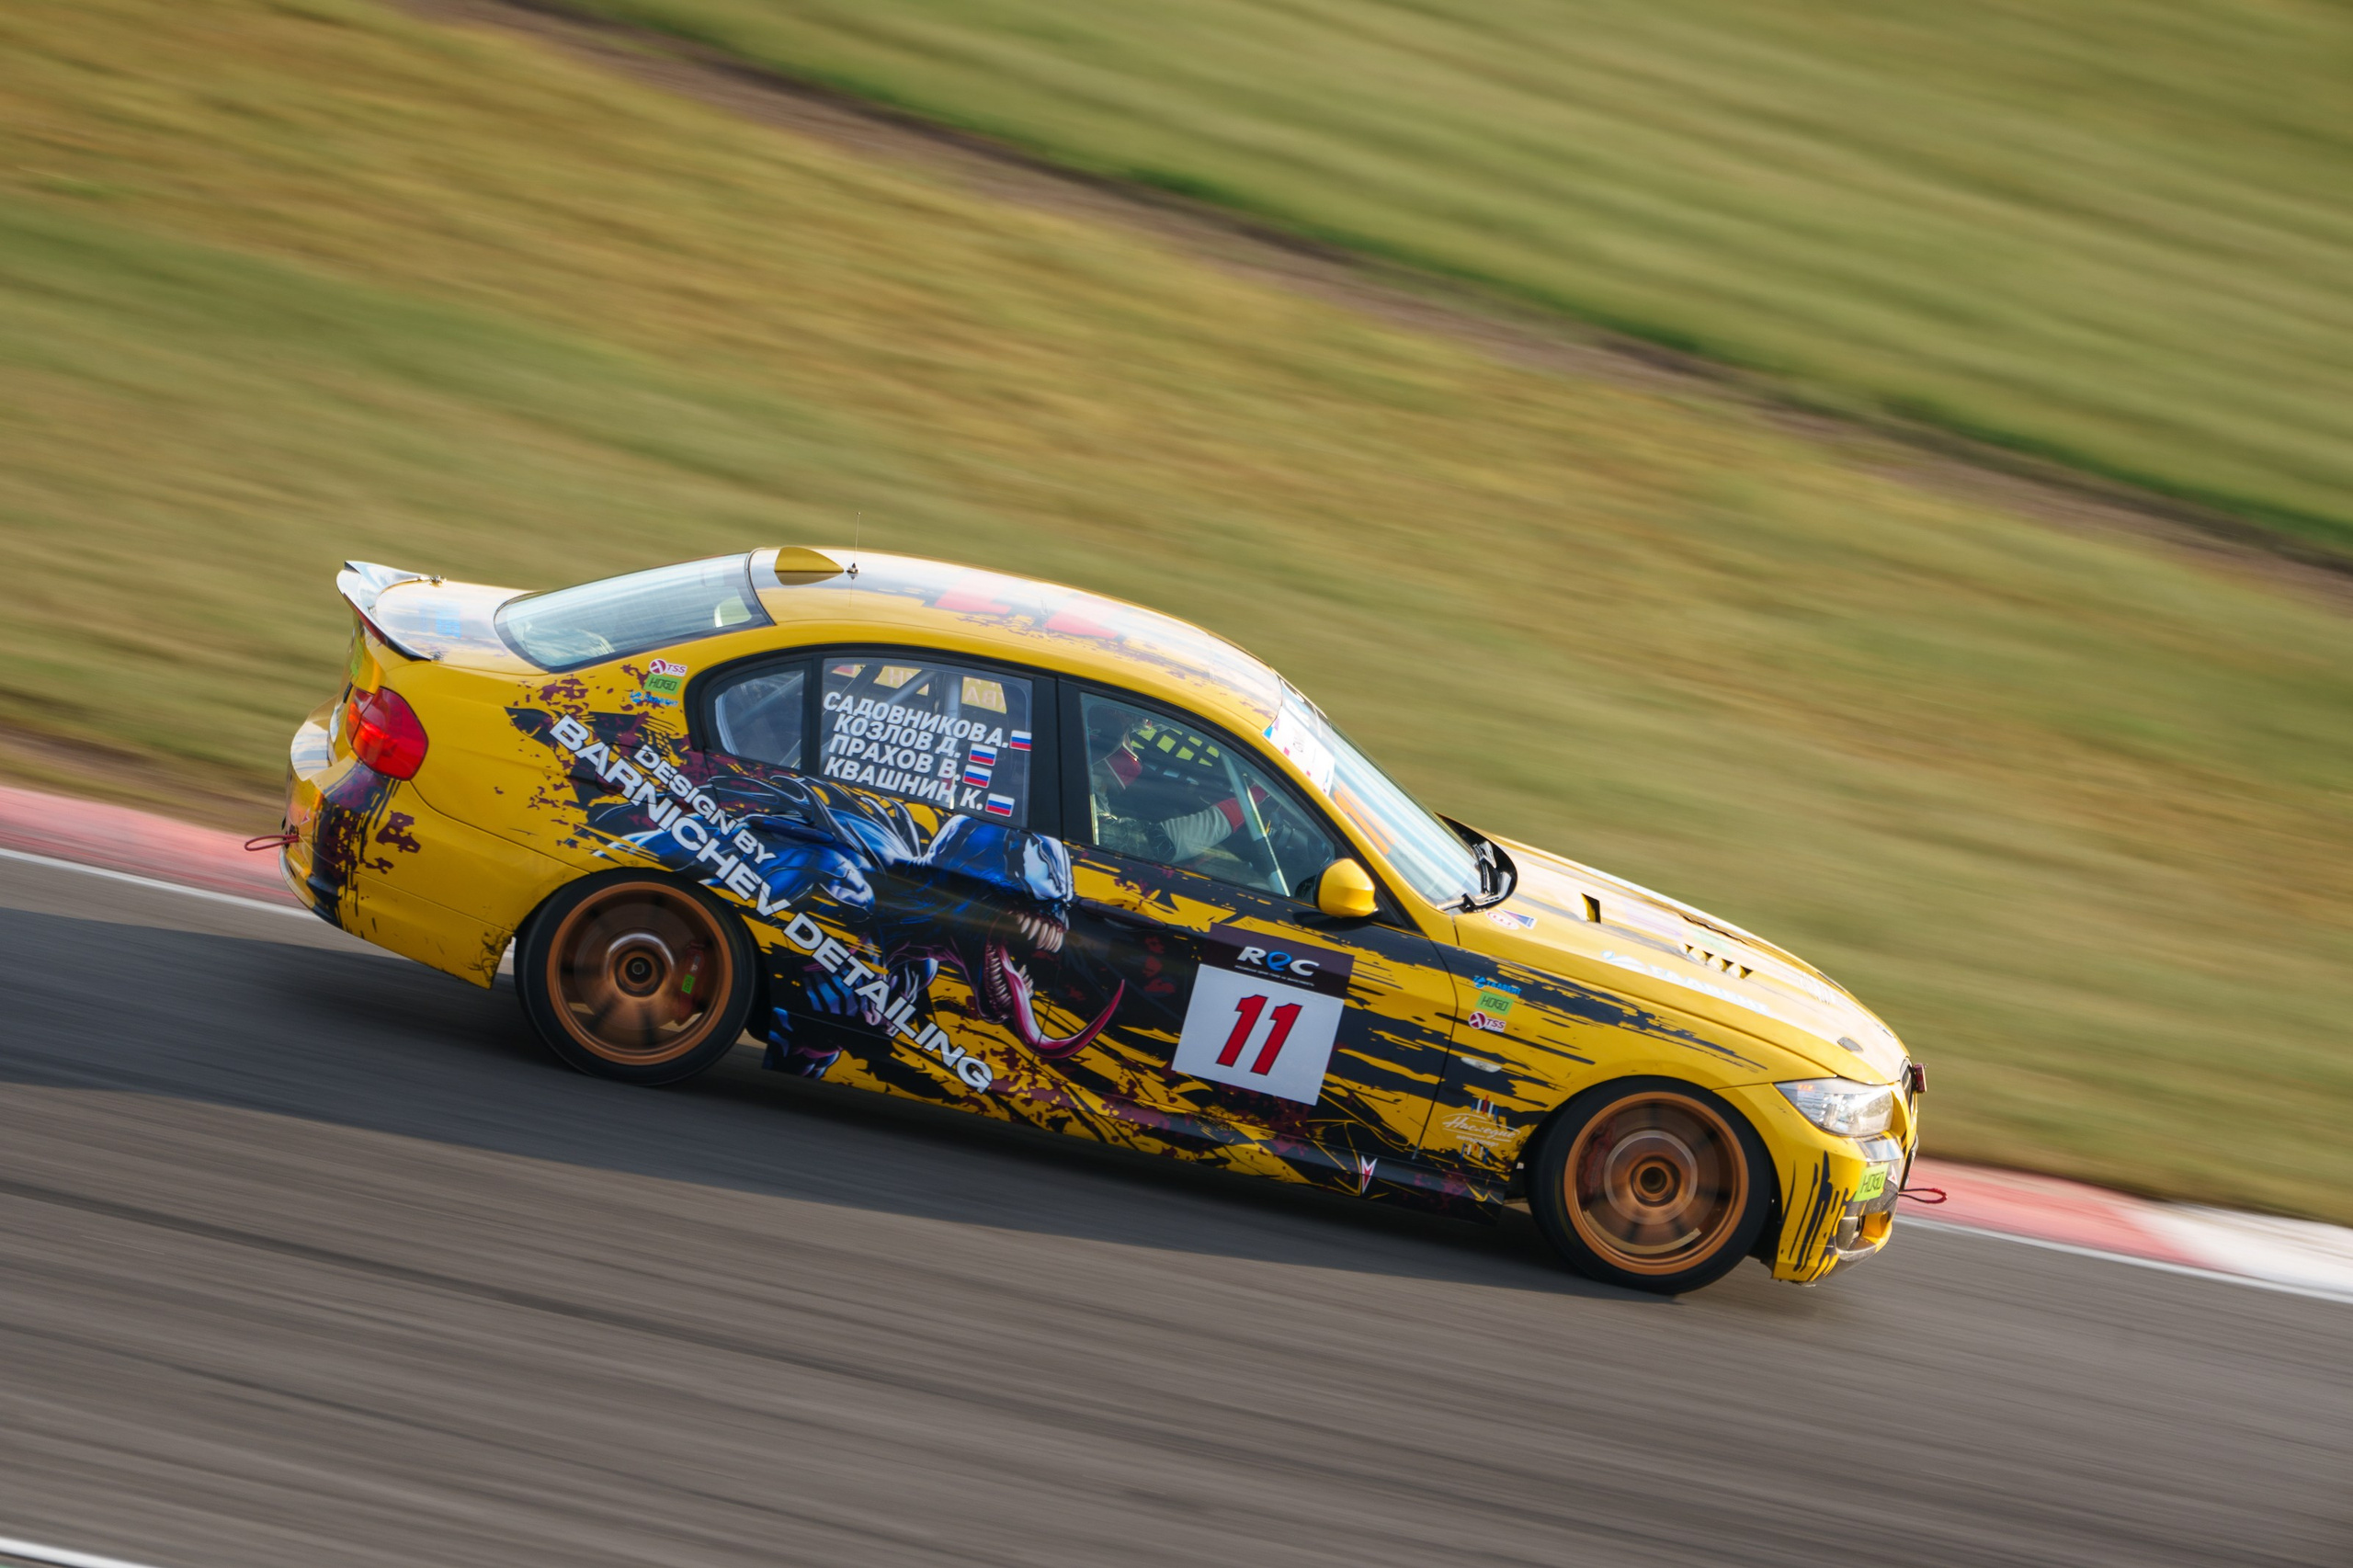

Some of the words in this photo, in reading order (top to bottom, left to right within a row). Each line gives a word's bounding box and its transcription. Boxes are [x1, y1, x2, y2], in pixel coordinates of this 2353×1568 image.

[667, 664, 687, 674] TSS
[827, 733, 934, 774] ПРАХОВ
[938, 758, 961, 781] В.
[833, 713, 934, 752] КОЗЛОВ
[935, 737, 961, 758] Д.
[633, 744, 739, 836] DESIGN
[733, 827, 778, 864] BY
[824, 756, 958, 803] КВАШНИН
[960, 787, 983, 811] К.
[549, 714, 791, 917] BARNICHEV
[783, 912, 995, 1094] DETAILING
[1215, 994, 1303, 1076] 11
[1486, 1018, 1506, 1029] TSS
